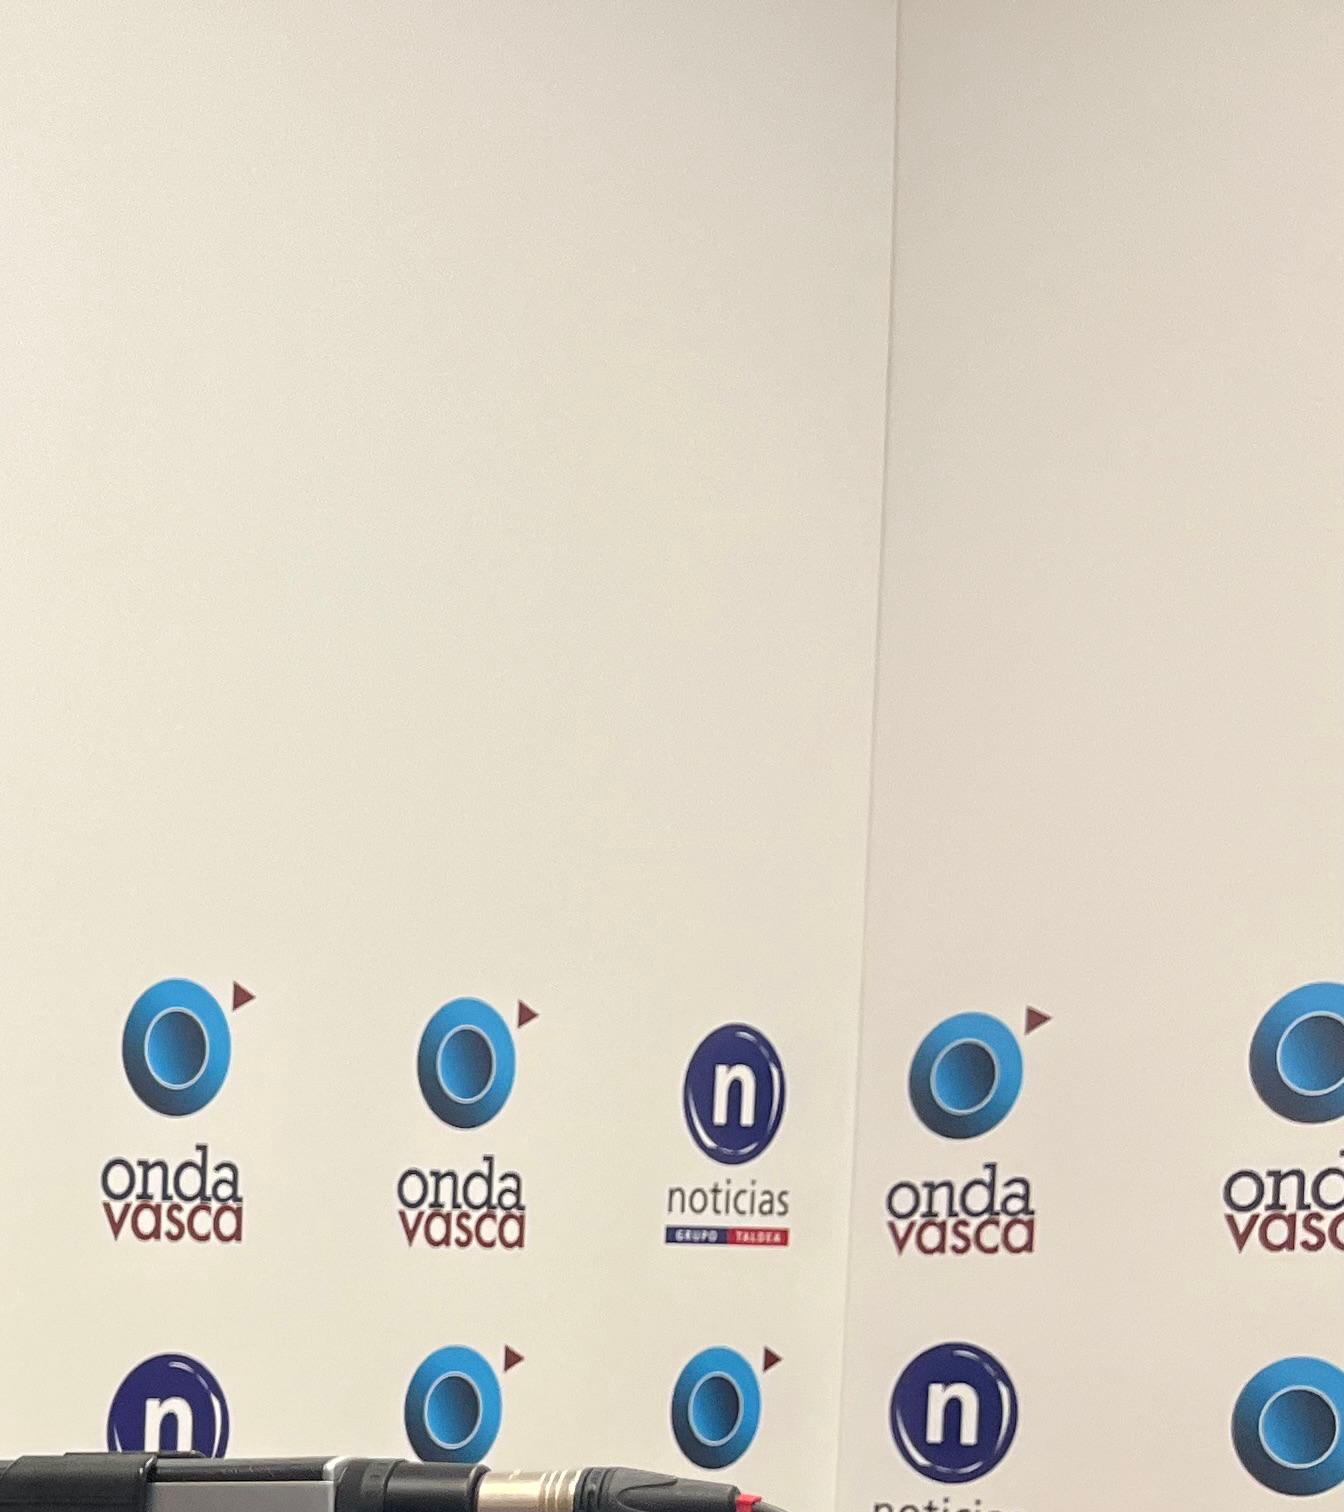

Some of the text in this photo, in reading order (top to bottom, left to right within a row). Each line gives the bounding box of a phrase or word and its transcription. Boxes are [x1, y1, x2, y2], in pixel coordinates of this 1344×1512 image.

[713, 1063, 756, 1126] n
[101, 1145, 243, 1204] onda
[397, 1156, 526, 1212] onda
[667, 1179, 789, 1217] noticias
[887, 1163, 1035, 1218] onda
[1223, 1150, 1344, 1213] ond
[103, 1200, 243, 1243] vasca
[399, 1207, 526, 1249] vasca
[675, 1229, 781, 1243] GRUPO TALDEA
[889, 1215, 1035, 1257] vasca
[1224, 1212, 1344, 1254] vasc
[926, 1382, 980, 1446] n
